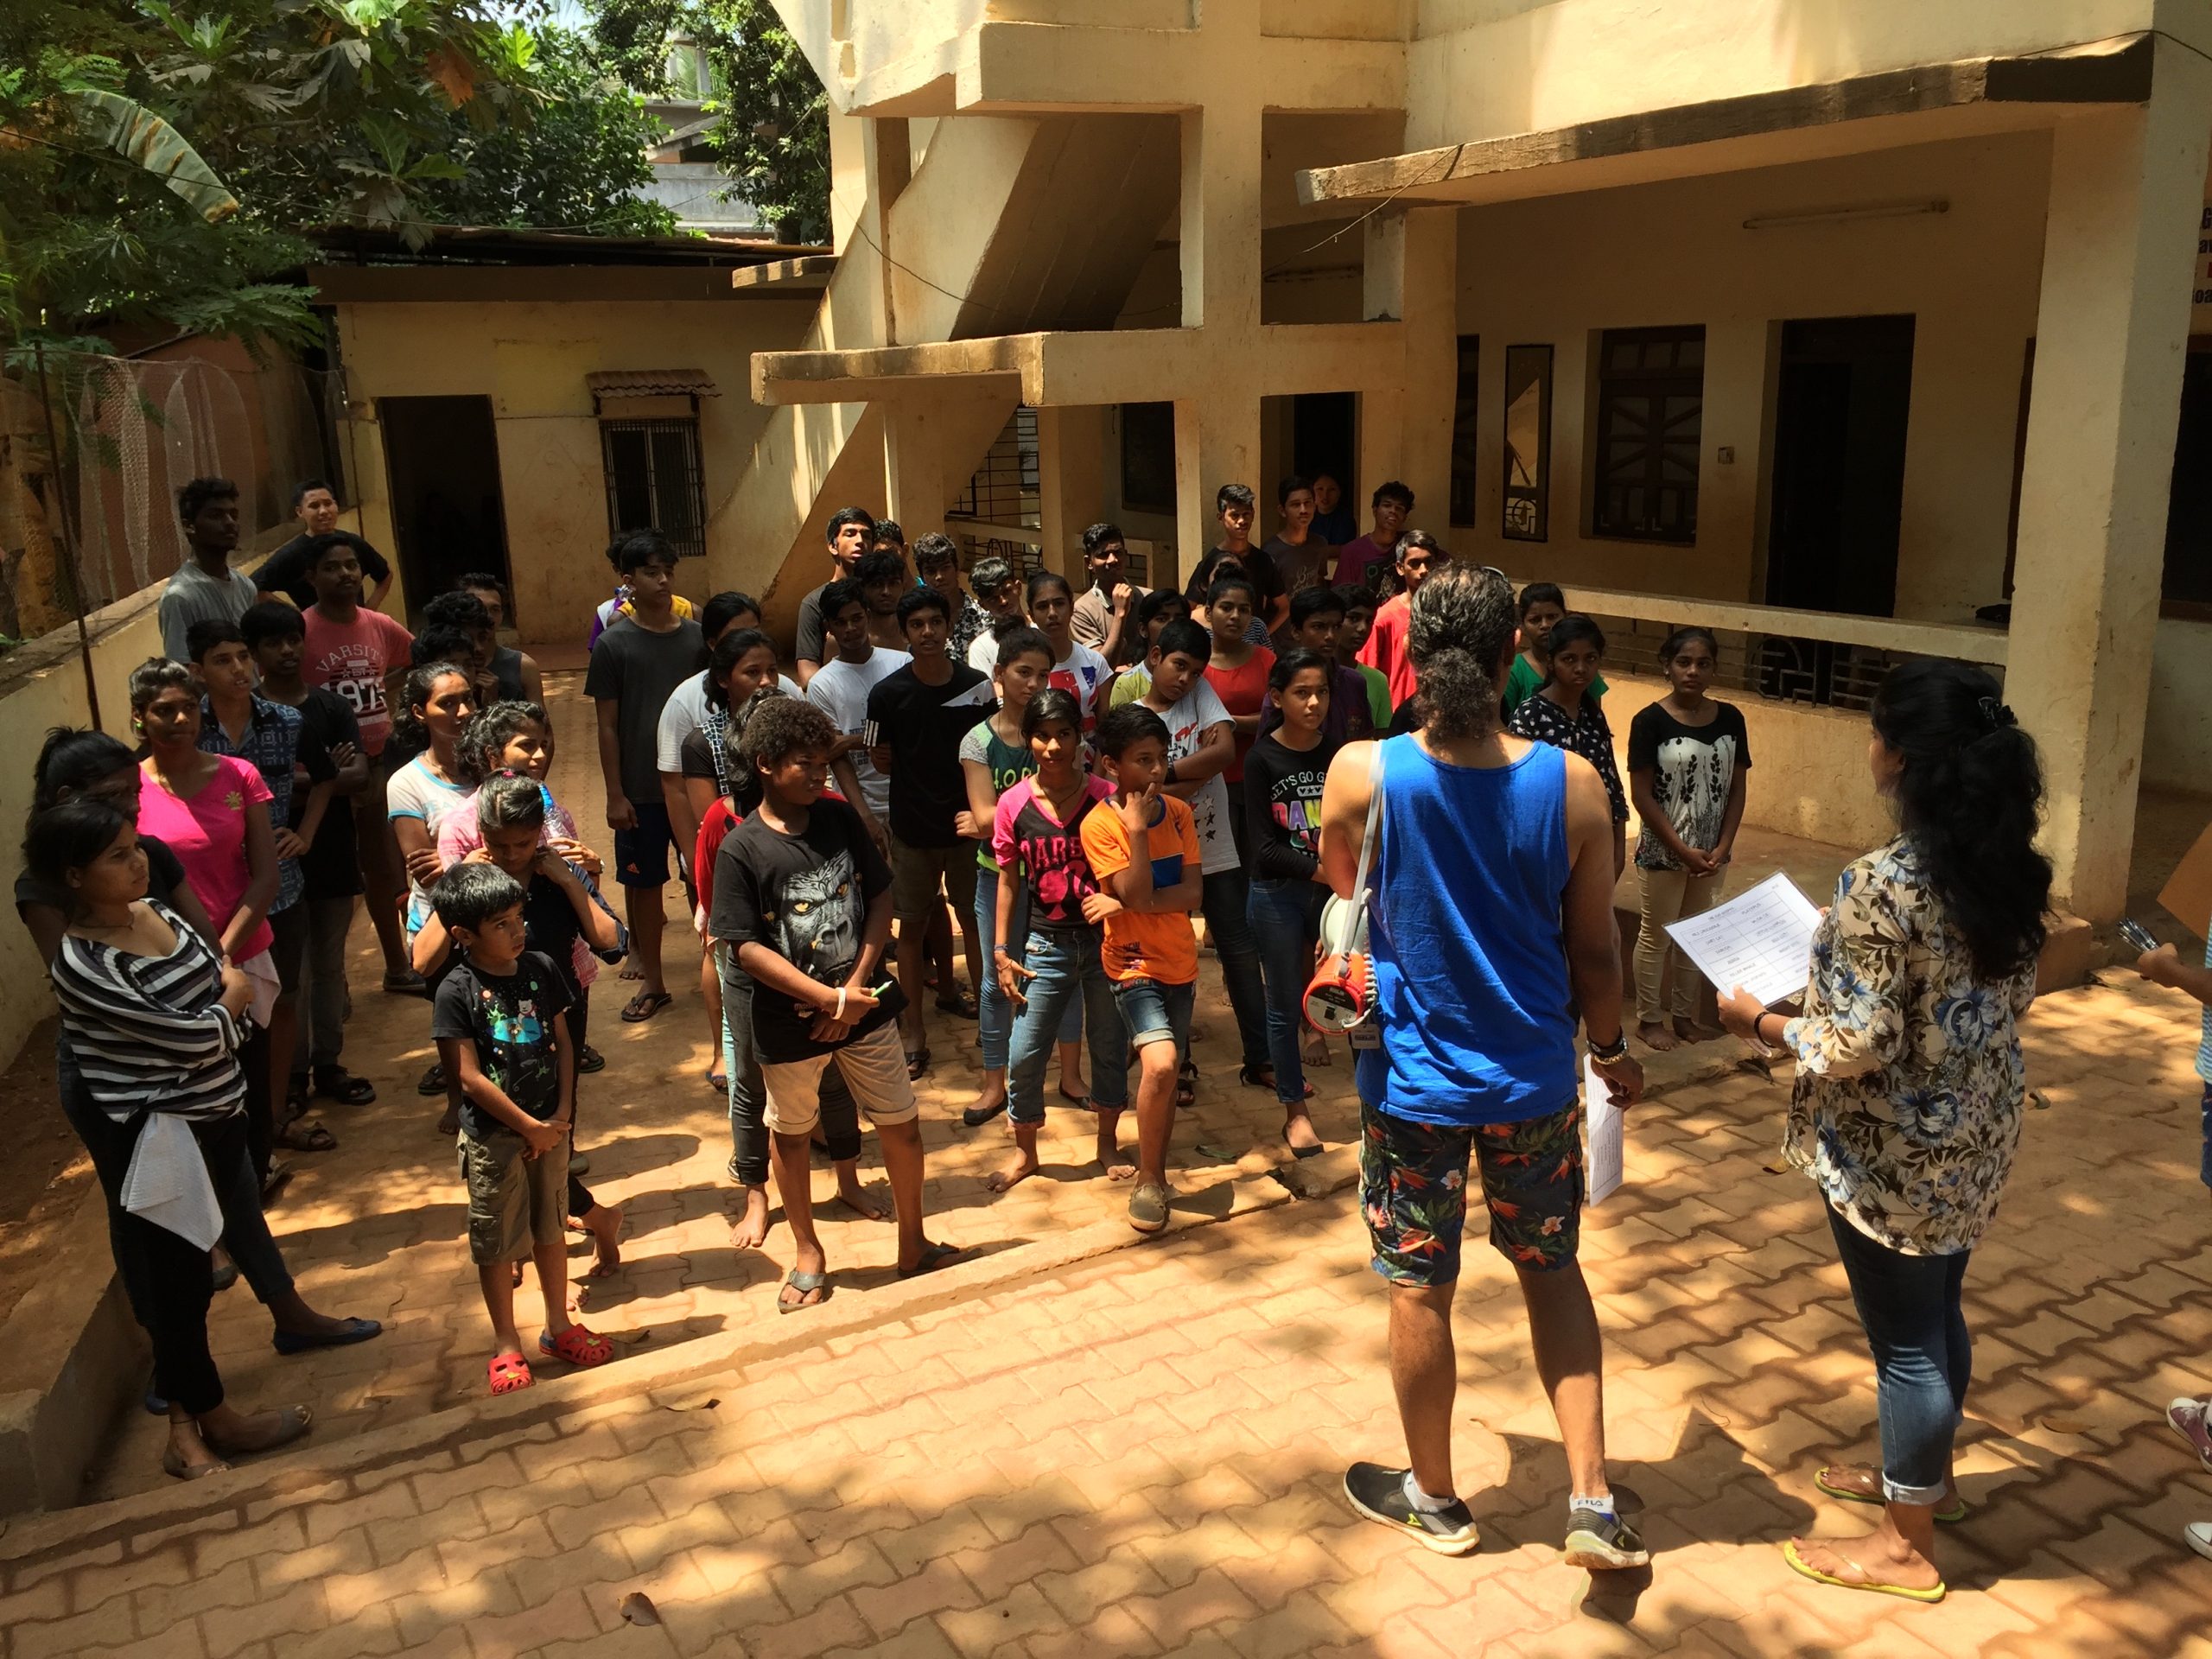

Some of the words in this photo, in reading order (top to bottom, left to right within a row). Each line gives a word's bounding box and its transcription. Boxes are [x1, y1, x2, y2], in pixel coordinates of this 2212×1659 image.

[315, 644, 384, 672] VARSIT
[1299, 770, 1314, 784] GO
[1271, 798, 1322, 830] DAN
